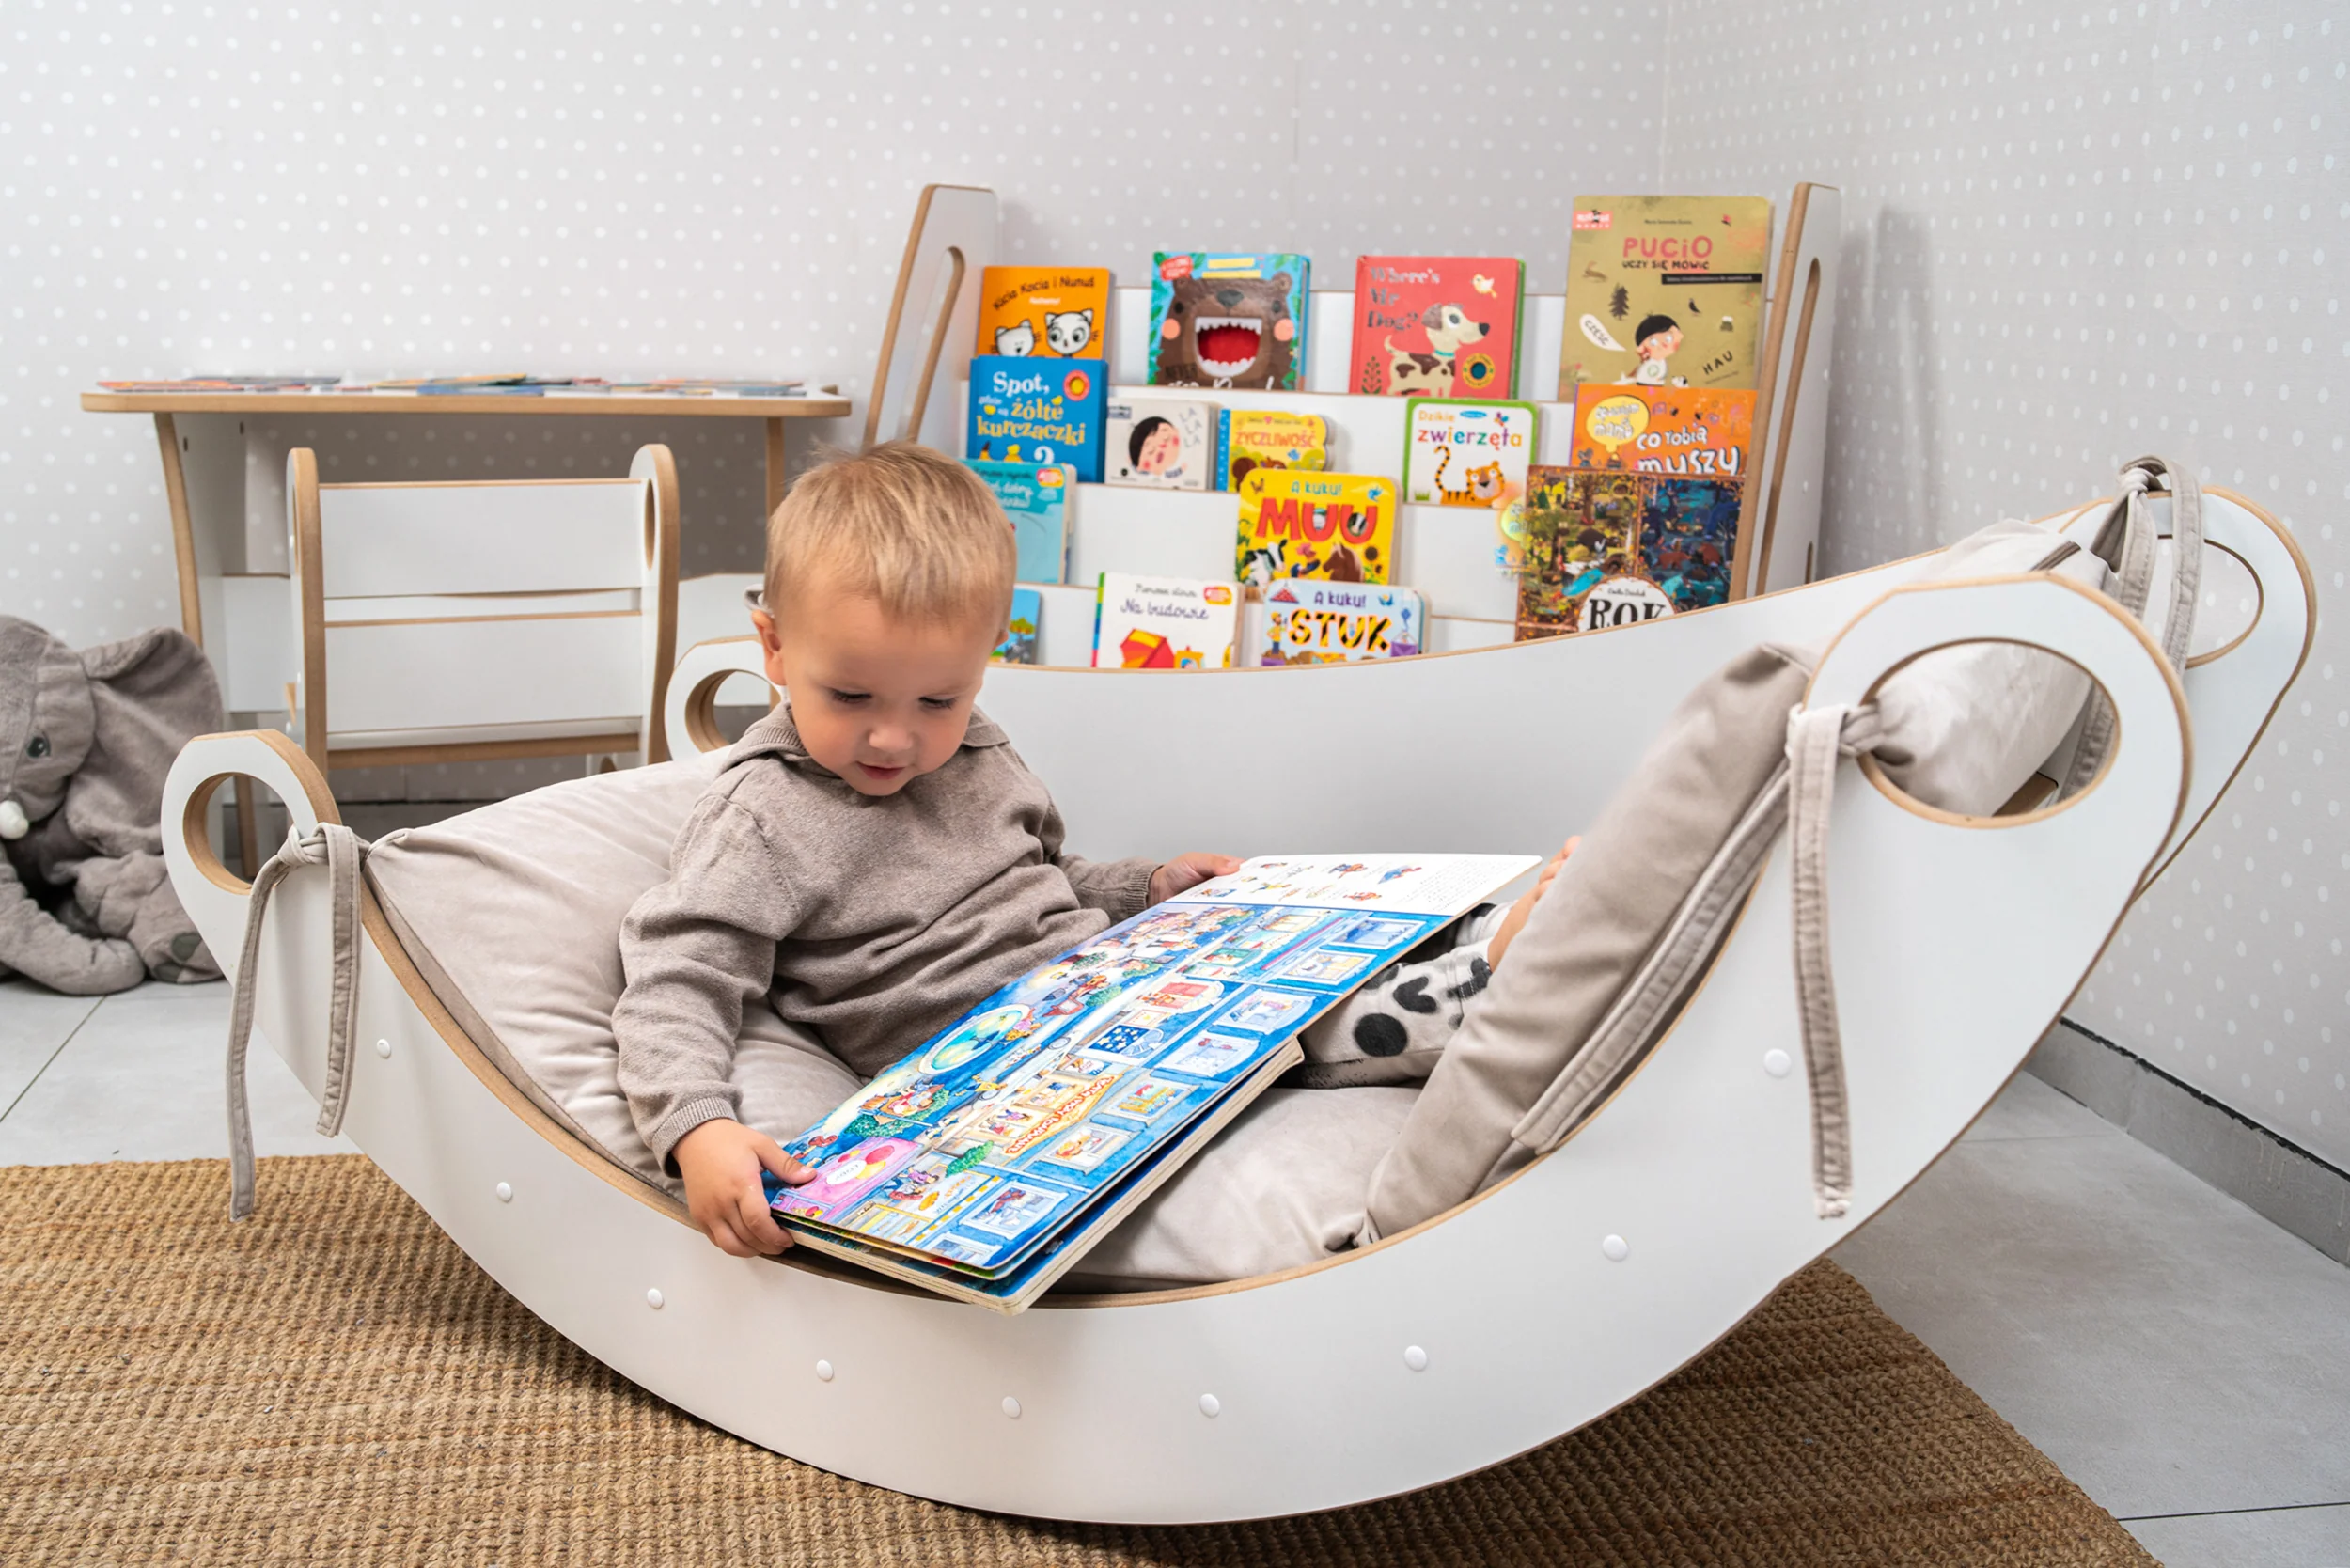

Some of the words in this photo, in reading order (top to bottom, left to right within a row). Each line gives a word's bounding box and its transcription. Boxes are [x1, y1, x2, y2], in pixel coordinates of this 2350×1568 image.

[1369, 266, 1440, 284] Where's
[1369, 288, 1400, 306] Mr
[1367, 310, 1418, 331] Dog?
[1702, 351, 1733, 375] HAU
[993, 371, 1050, 398] Spot,
[1418, 410, 1455, 422] Dzikie
[1418, 426, 1523, 451] zwierzęta
[1637, 431, 1662, 451] co
[1292, 480, 1300, 494] A
[1305, 482, 1342, 496] kuku!
[1255, 497, 1378, 544] MUU
[1314, 591, 1324, 604] A
[1328, 592, 1366, 608] kuku!
[1288, 608, 1392, 653] STUK
